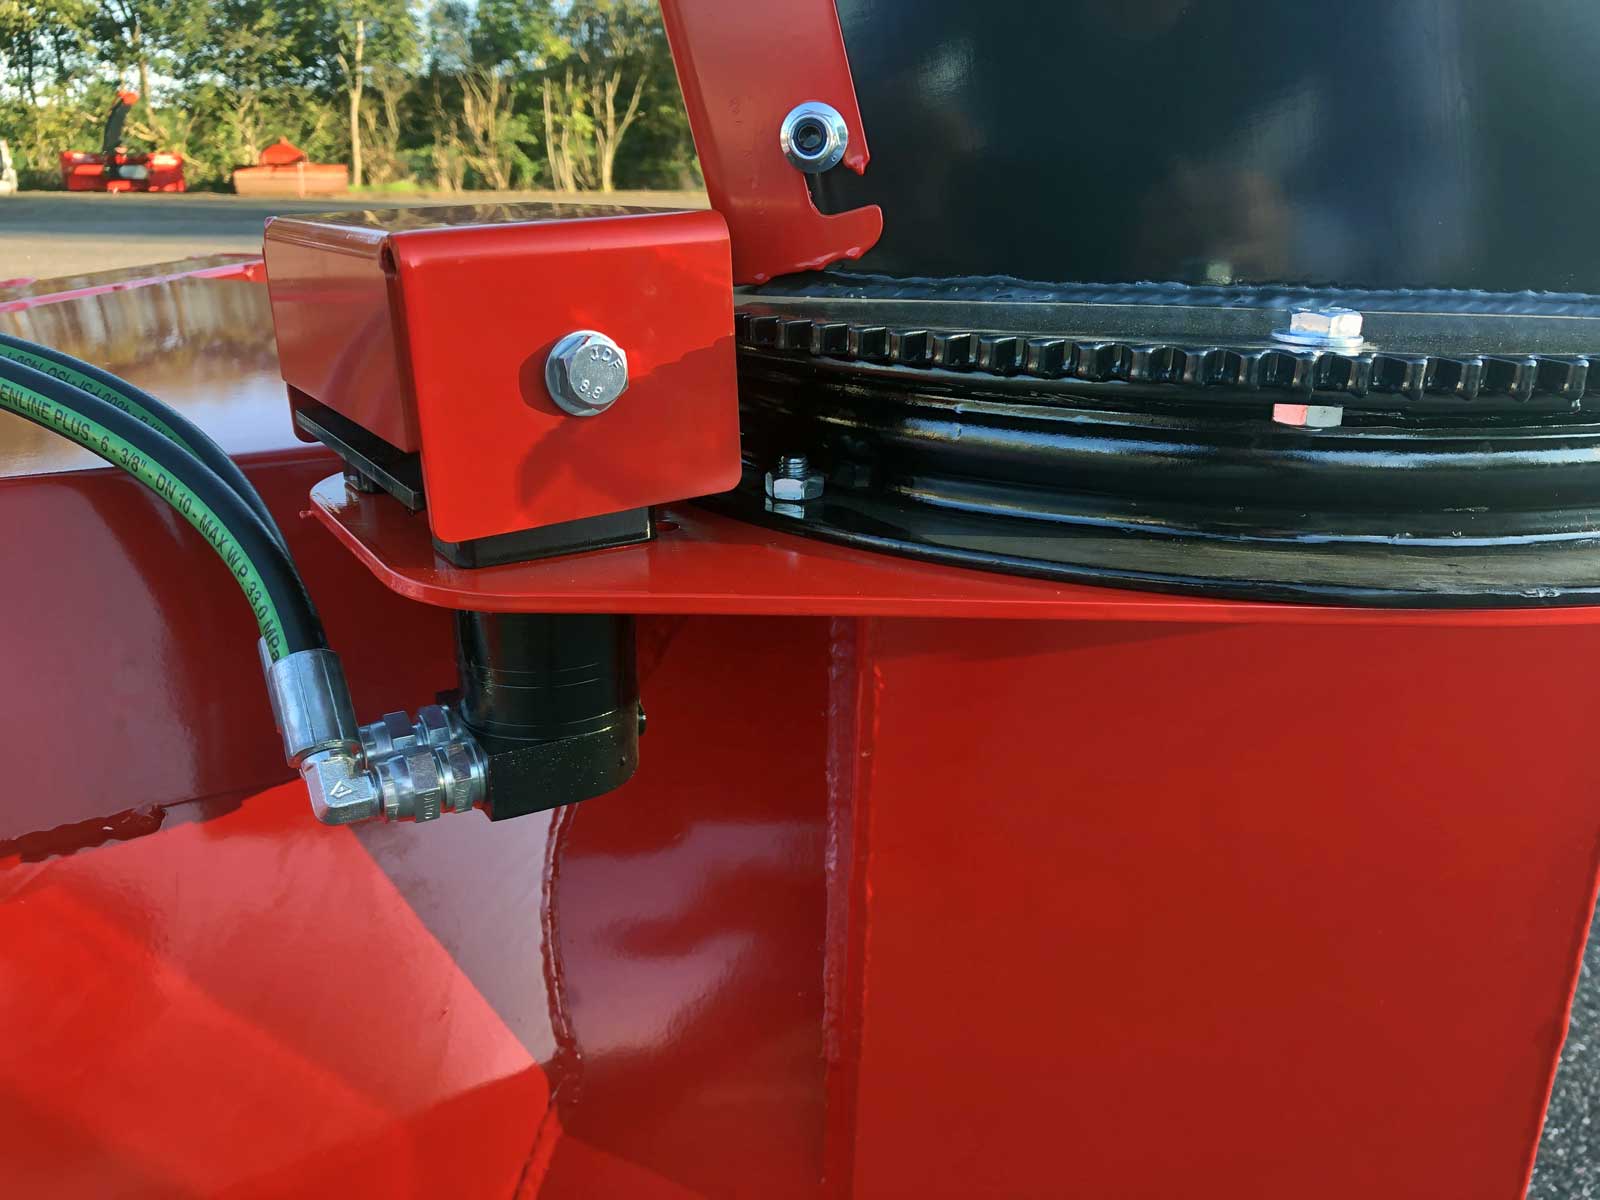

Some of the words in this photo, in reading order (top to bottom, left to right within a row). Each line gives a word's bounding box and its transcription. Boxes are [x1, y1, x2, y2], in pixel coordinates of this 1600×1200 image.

[54, 408, 90, 442] PLUS
[100, 435, 110, 453] 6
[156, 473, 178, 501] DN
[178, 492, 193, 515] 10
[199, 512, 229, 554] MAX
[246, 581, 269, 620] 33.0
[263, 618, 281, 663] MPa
